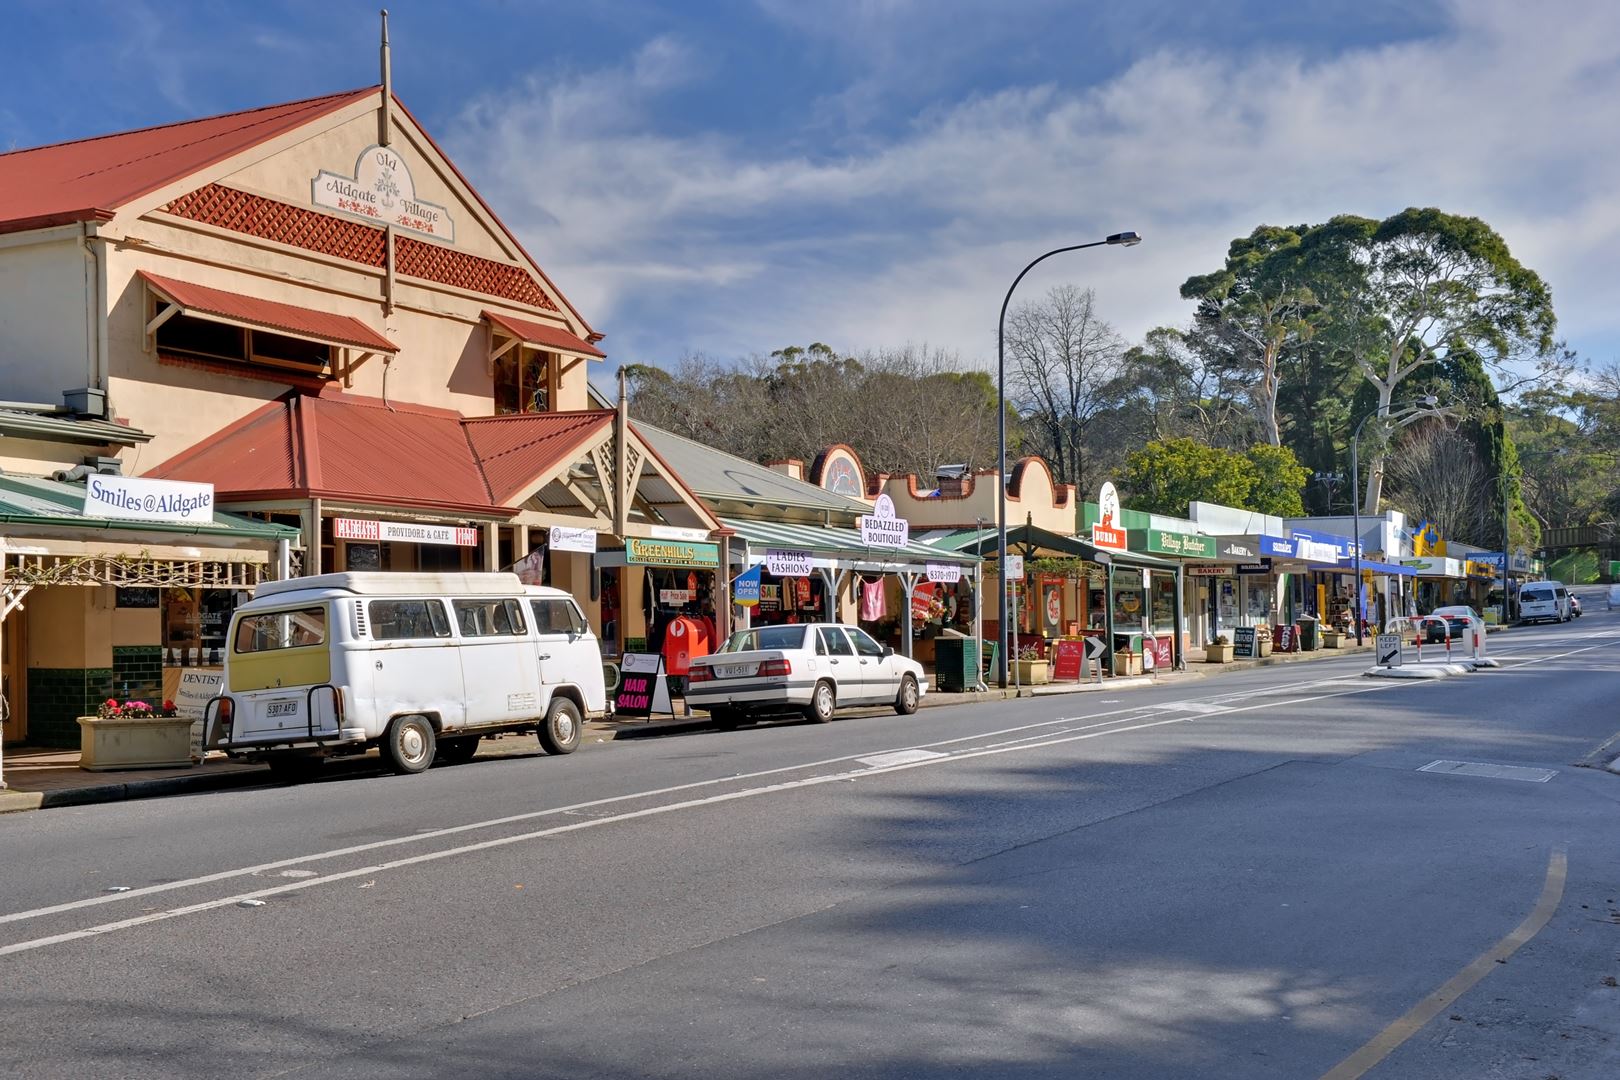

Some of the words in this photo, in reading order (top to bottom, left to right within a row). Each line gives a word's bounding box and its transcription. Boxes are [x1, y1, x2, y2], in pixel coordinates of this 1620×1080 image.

[376, 153, 397, 171] Old
[327, 179, 376, 204] Aldgate
[400, 198, 438, 222] Village
[91, 480, 210, 517] Smiles@Aldgate
[865, 519, 904, 532] BEDAZZLED
[387, 526, 426, 539] PROVIDORE
[426, 530, 432, 540] &
[868, 532, 902, 544] BOUTIQUE
[1161, 532, 1181, 553] Village
[776, 551, 806, 562] LADIES
[771, 563, 810, 574] FASHIONS
[930, 570, 958, 580] 8370-1977
[738, 580, 758, 588] NOW
[183, 674, 221, 685] DENTIST
[624, 678, 648, 692] HAIR
[617, 694, 649, 709] SALON
